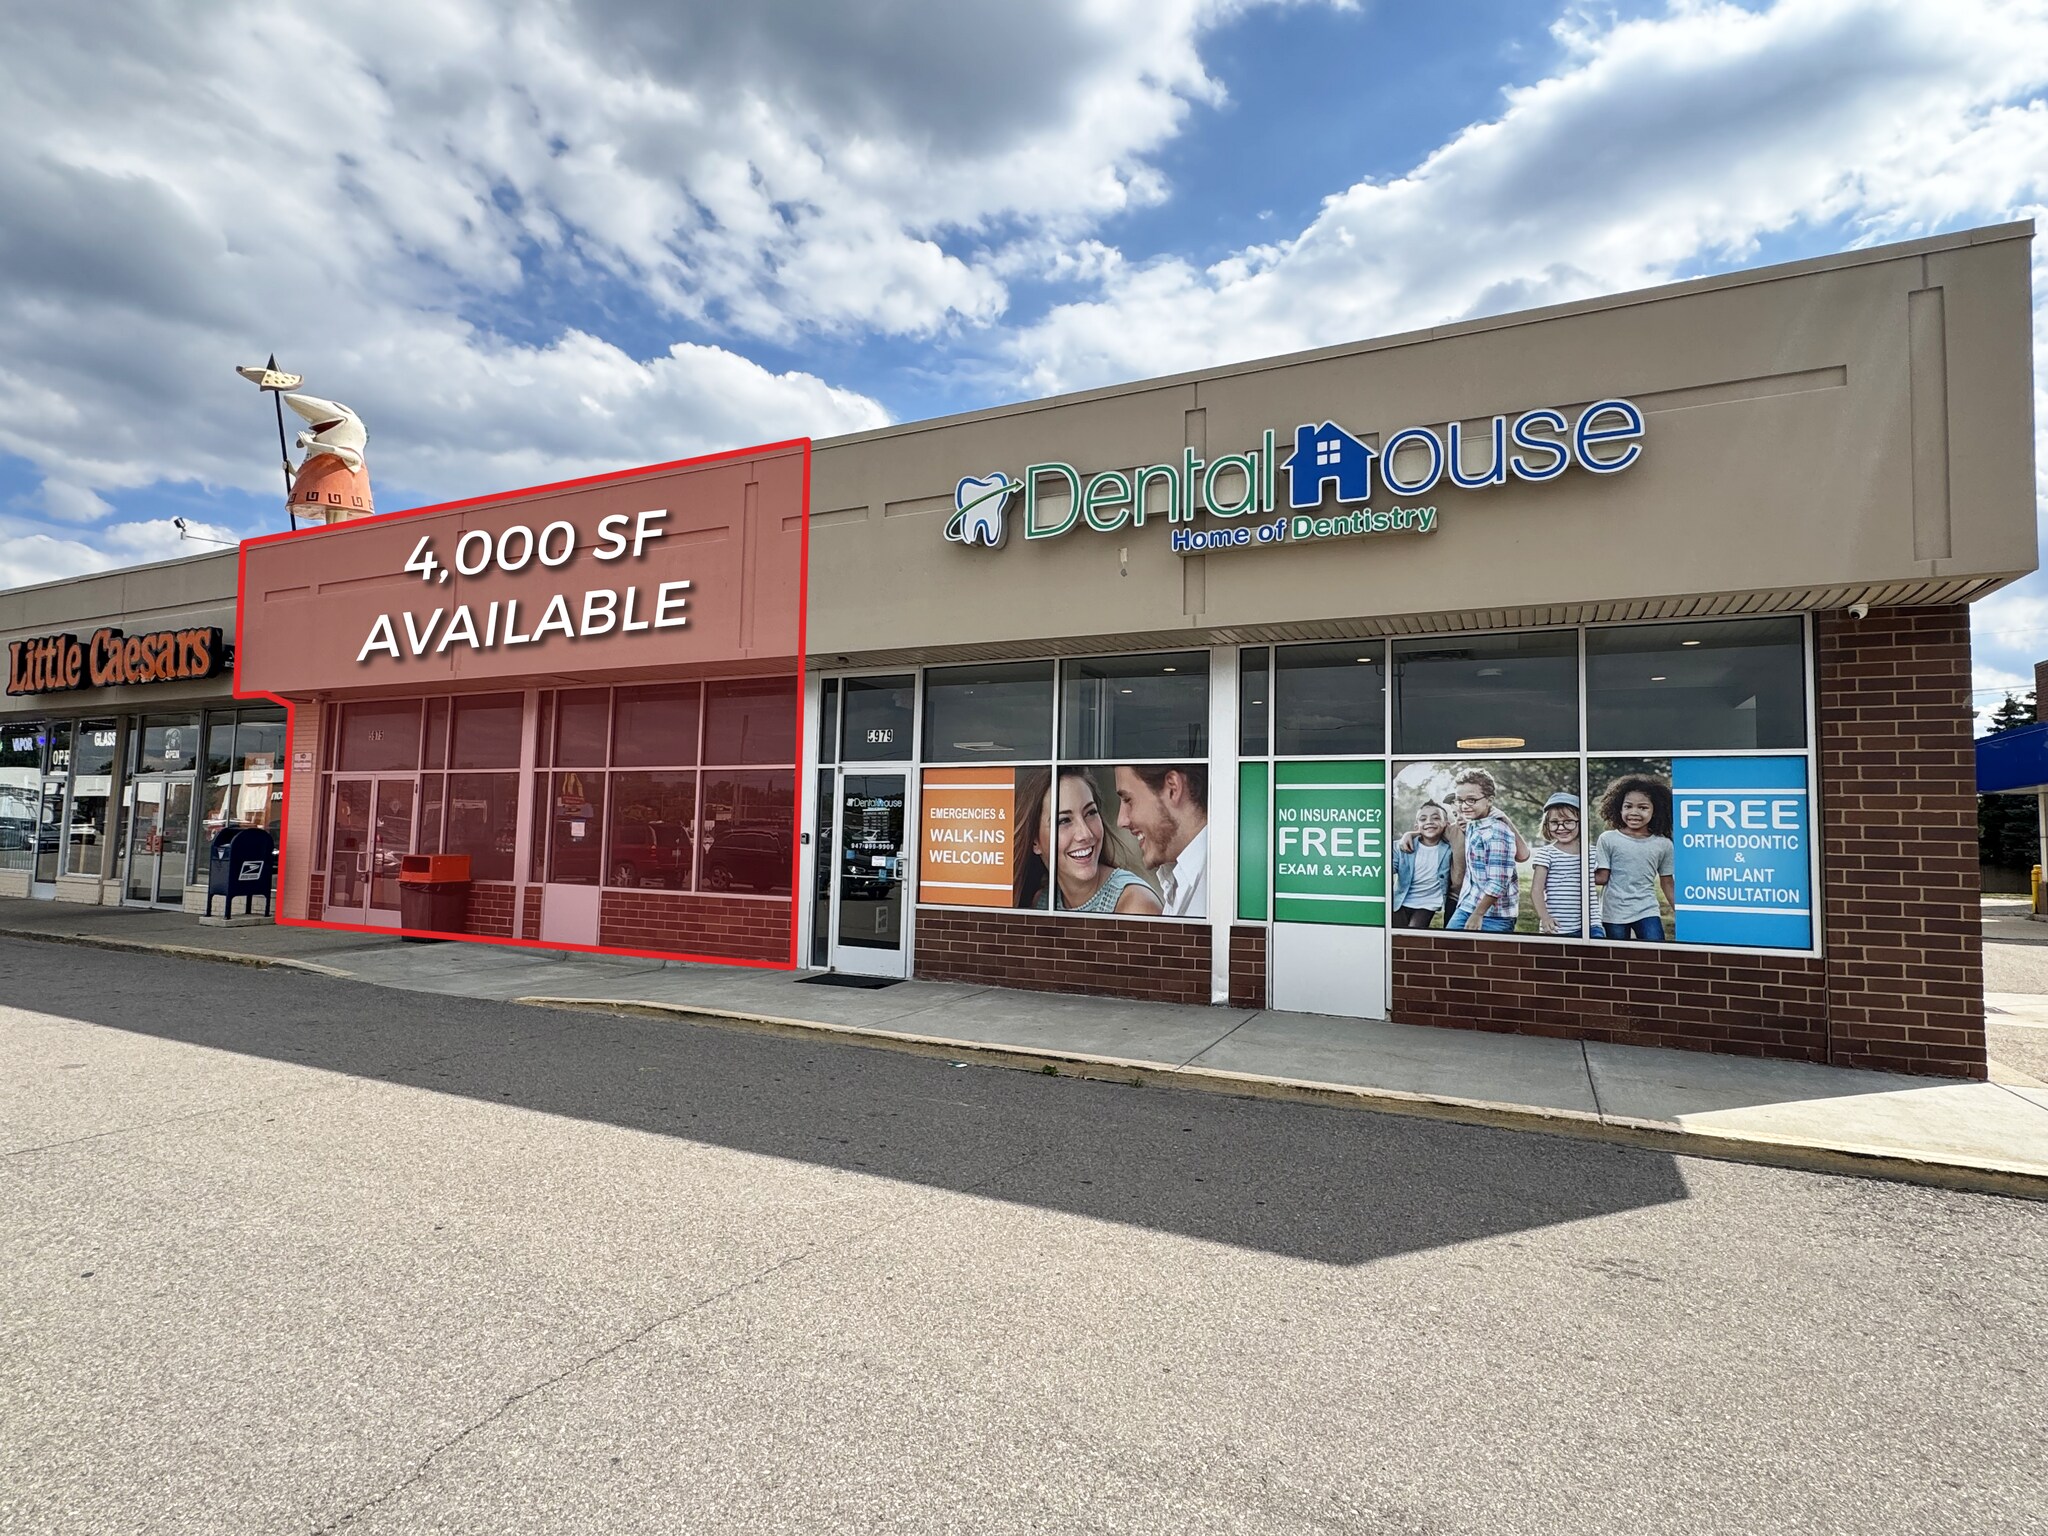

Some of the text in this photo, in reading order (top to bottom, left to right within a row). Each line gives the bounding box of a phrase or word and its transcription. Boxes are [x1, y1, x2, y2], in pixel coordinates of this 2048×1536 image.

[1171, 505, 1437, 552] Home of Dentistry
[7, 626, 216, 695] Little Caesars
[867, 729, 893, 742] 5979
[12, 737, 34, 752] VAPOR
[52, 749, 70, 766] OPE
[930, 807, 1006, 820] EMERGENCIES &
[1278, 808, 1382, 823] NO INSURANCE?
[1679, 799, 1801, 831] FREE
[929, 828, 1006, 844] WALK-INS
[1278, 826, 1383, 859] FREE
[1682, 833, 1799, 850] ORTHODONTIC
[929, 849, 1006, 866] WELCOME
[1733, 852, 1746, 863] &
[1278, 863, 1382, 878] EXAM & X-RAY
[1705, 867, 1776, 884] IMPLANT
[1684, 885, 1800, 904] CONSULTATION
